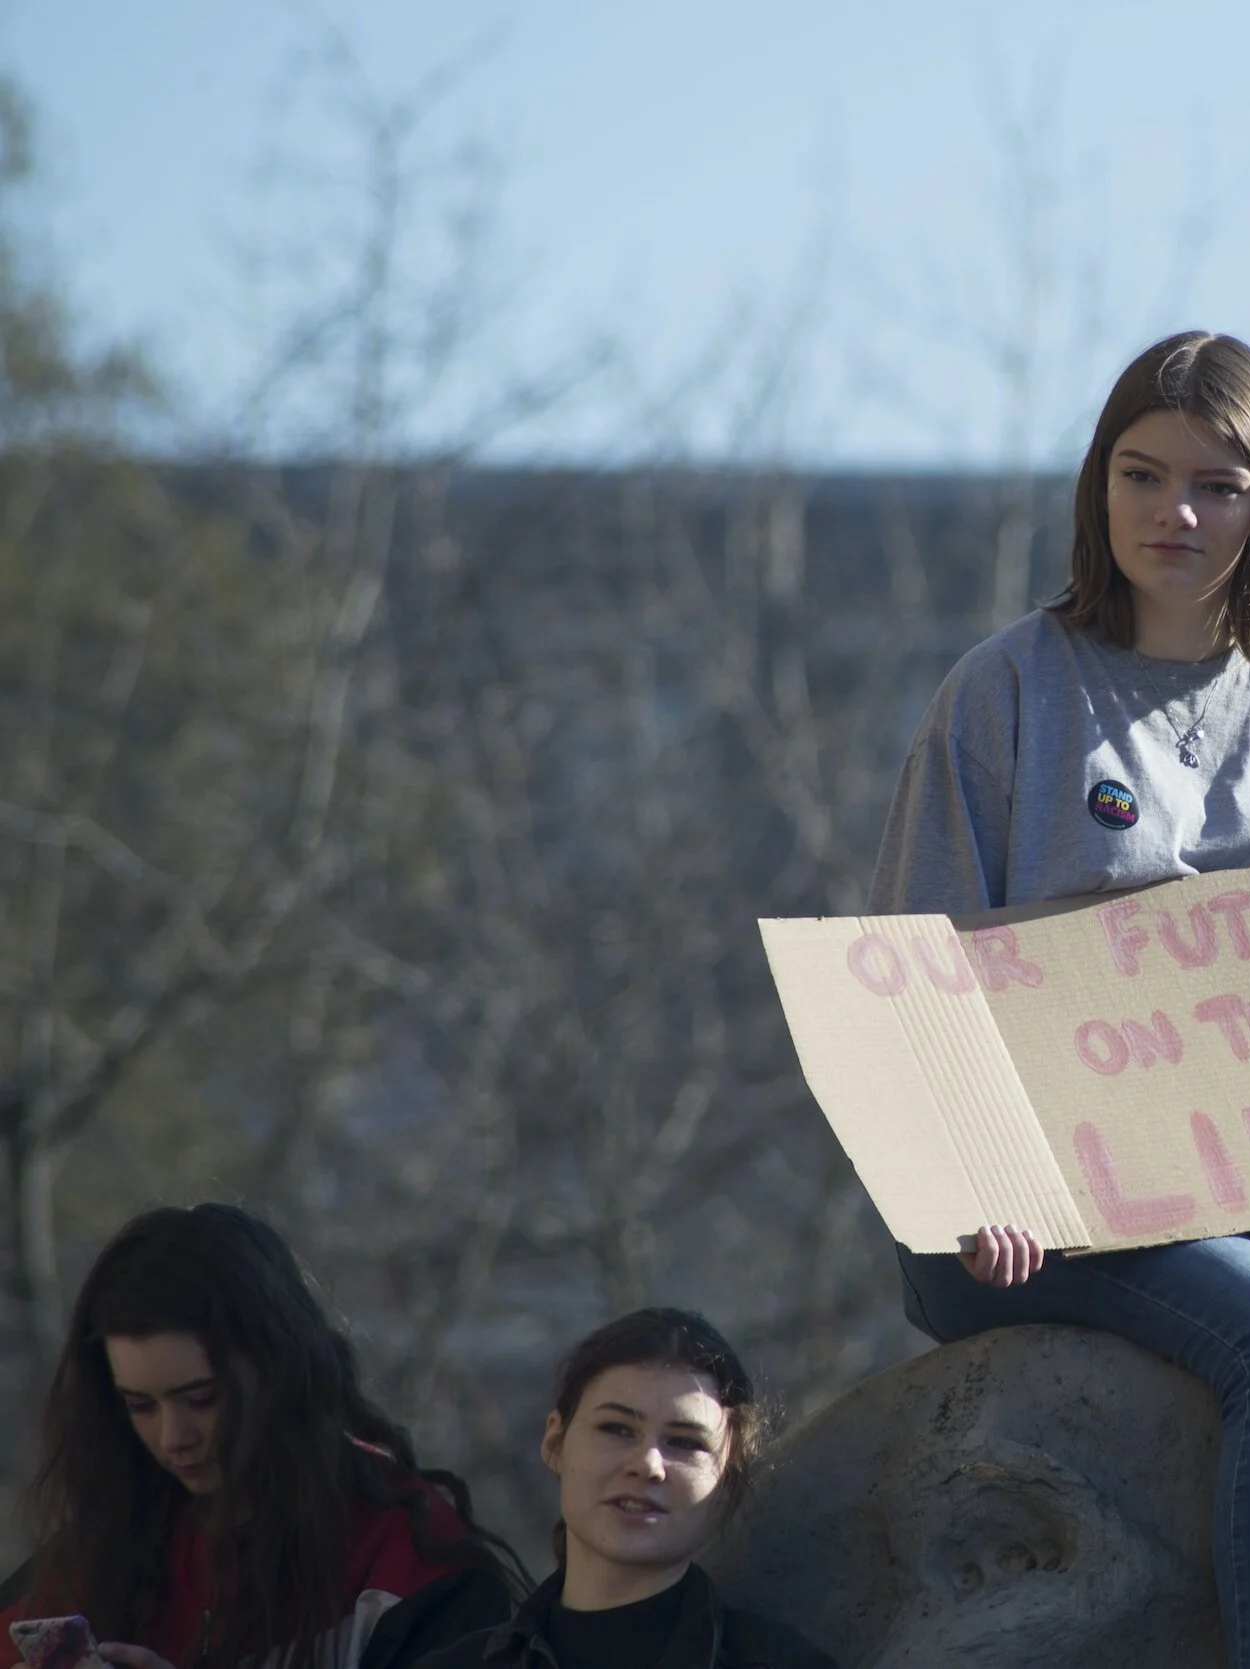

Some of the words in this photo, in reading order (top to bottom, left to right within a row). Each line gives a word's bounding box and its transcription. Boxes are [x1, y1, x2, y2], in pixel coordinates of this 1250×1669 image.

[1098, 793, 1113, 804] UP
[1115, 799, 1130, 811] TO
[1100, 784, 1133, 803] STAND
[1095, 802, 1136, 823] RACISM
[848, 920, 1043, 997] OUR
[1074, 1009, 1183, 1075] ON
